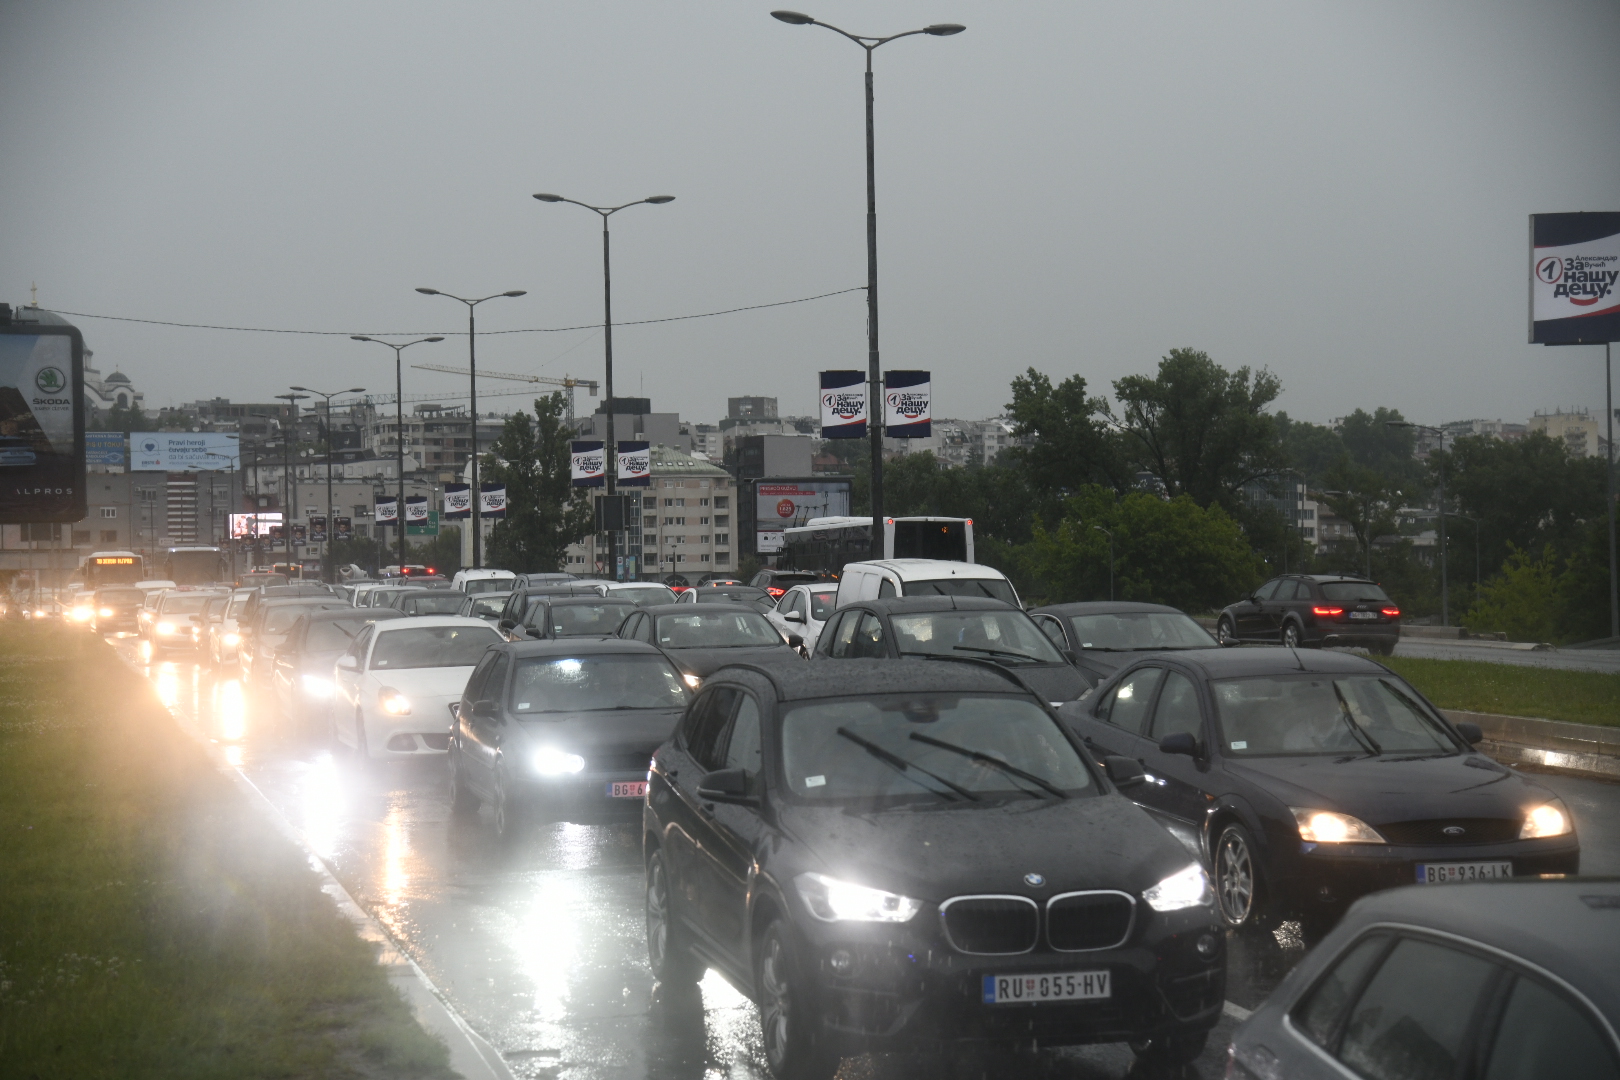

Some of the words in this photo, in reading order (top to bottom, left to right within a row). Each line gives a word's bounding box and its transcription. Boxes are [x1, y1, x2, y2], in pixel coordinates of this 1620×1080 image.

[1542, 260, 1556, 279] 1
[1564, 258, 1584, 271] За
[1584, 261, 1606, 269] Вучић
[1564, 271, 1619, 286] нашу
[1554, 283, 1611, 298] децу.
[826, 396, 832, 406] 1
[837, 400, 864, 408] нашу
[890, 395, 897, 405] 1
[901, 400, 929, 408] нашу
[832, 407, 861, 415] децу.
[896, 406, 925, 414] децу.
[614, 784, 628, 796] BG
[1428, 867, 1446, 882] BG
[999, 978, 1022, 998] RU
[1040, 974, 1106, 997] 055-HV
